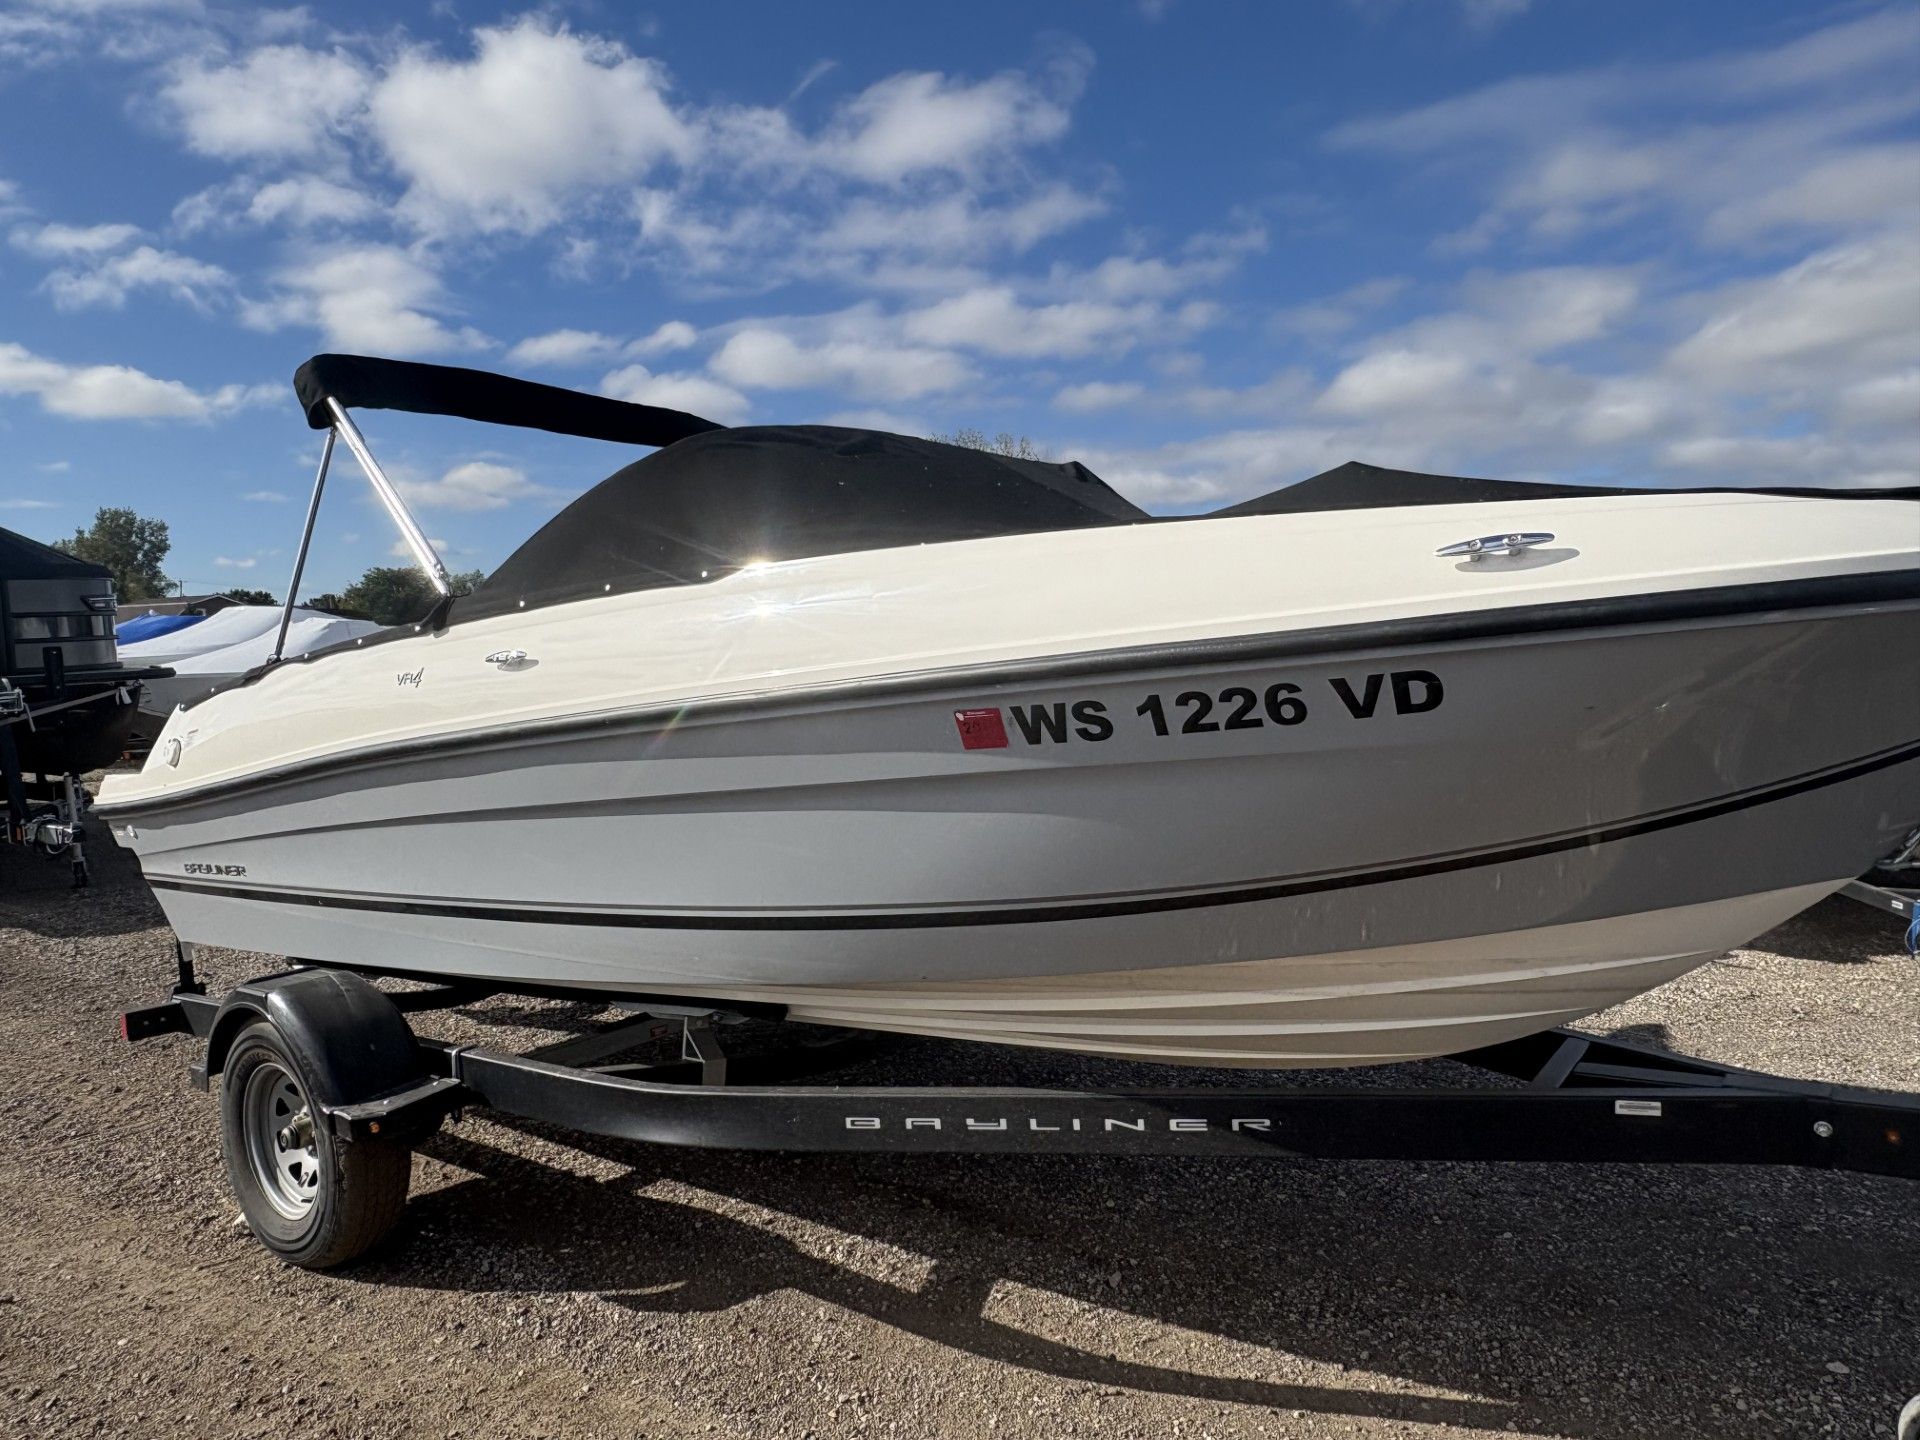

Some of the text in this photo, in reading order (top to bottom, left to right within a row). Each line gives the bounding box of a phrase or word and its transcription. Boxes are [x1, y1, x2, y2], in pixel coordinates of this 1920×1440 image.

[1008, 669, 1444, 745] WS 1226 VD
[845, 1116, 1272, 1132] BAYLINER
